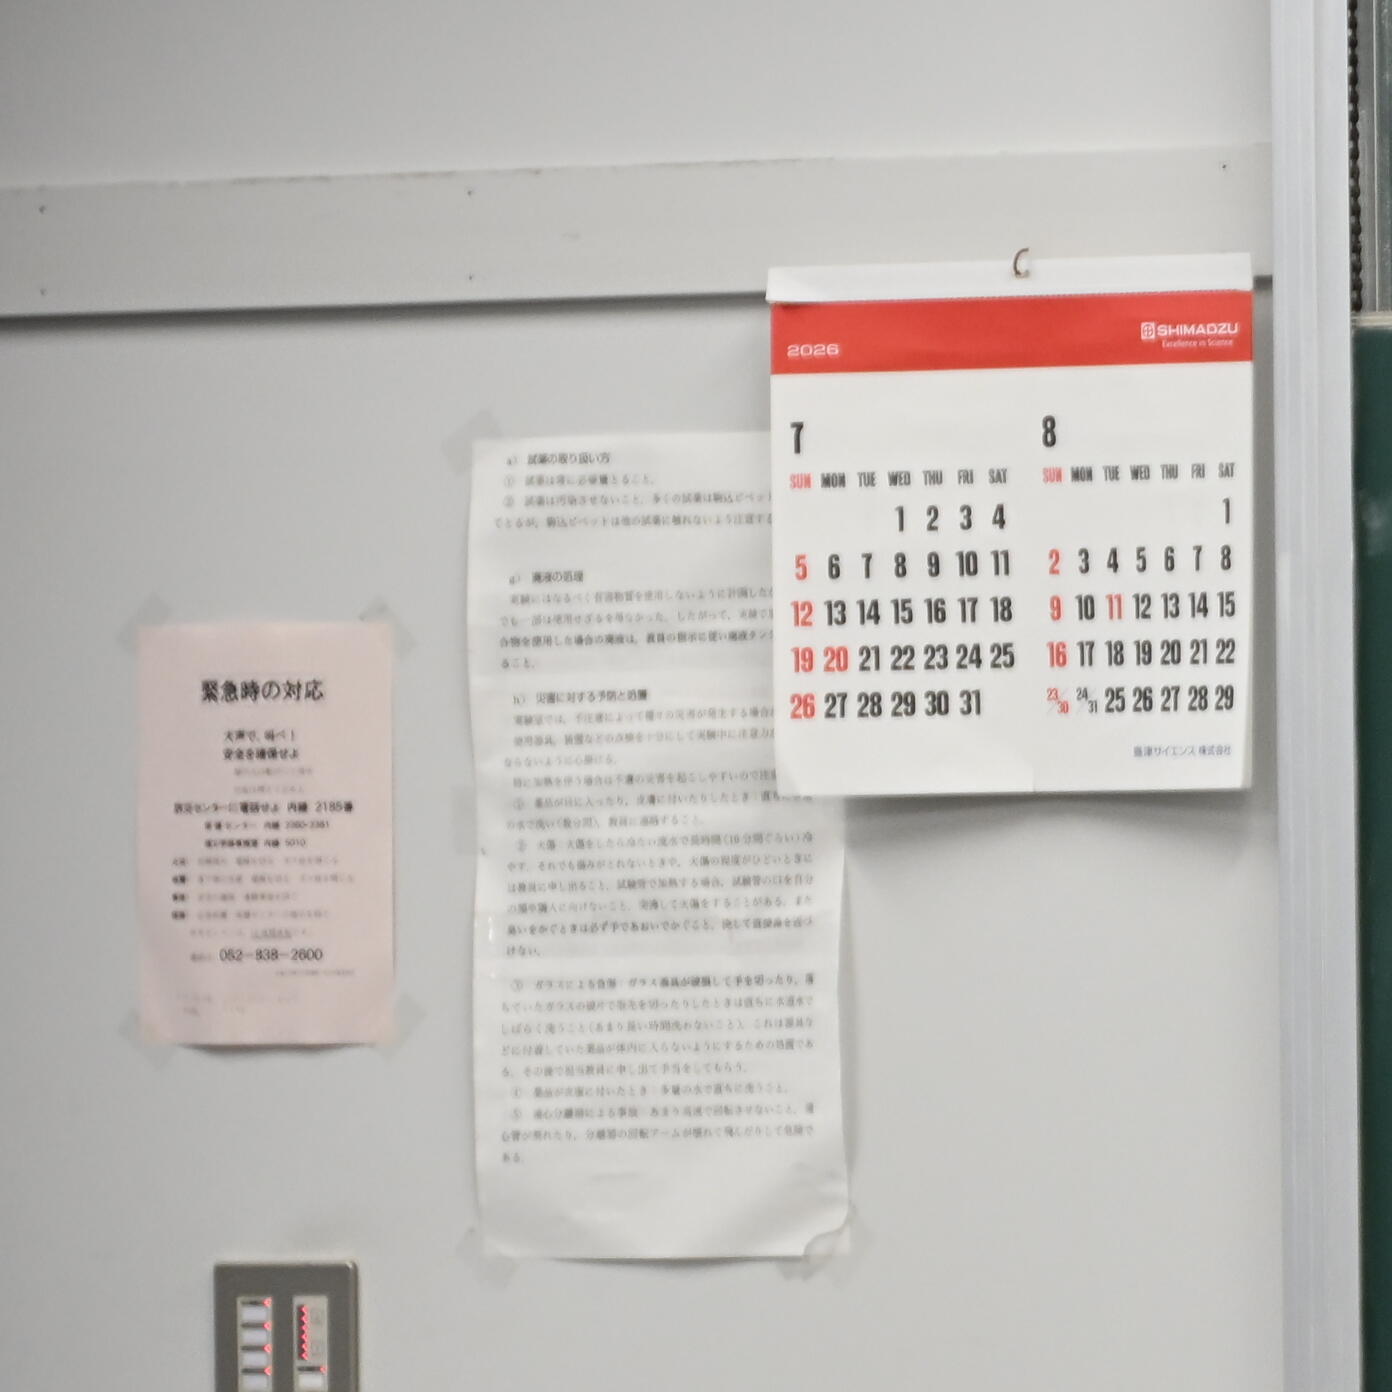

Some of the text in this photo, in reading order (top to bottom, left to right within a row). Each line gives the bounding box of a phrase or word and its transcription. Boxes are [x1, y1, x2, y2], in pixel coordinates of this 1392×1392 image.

[1157, 321, 1239, 336] SHIMADZU
[786, 343, 840, 358] 2026
[790, 421, 805, 455] 7
[1041, 414, 1057, 449] 8
[790, 468, 1008, 489] SUN MON TUE WED THU FRI SAT
[1043, 462, 1235, 483] SUN MON TUE WED THU FRI SAT
[894, 503, 1007, 533] 1 2 3 4
[1222, 497, 1231, 525] 1
[794, 549, 1011, 581] 5 6 7 8 9 10 11
[1048, 544, 1232, 576] 2 3 4 5 6 7 8
[790, 595, 1014, 628] 12 13 14 15 16 17 18
[1049, 590, 1236, 622] 9 10 11 12 13 14 15
[791, 641, 1016, 673] 19 20 21 22 23 24 25
[1046, 637, 1236, 668] 16 17 18 19 20 21 22
[201, 679, 325, 702] 緊急時の対応
[789, 688, 982, 720] 26 27 28 29 30 31
[1104, 686, 1127, 714] 25
[1132, 685, 1154, 714] 26
[1160, 684, 1181, 713] 27
[1187, 684, 1209, 713] 28
[1214, 684, 1235, 712] 29
